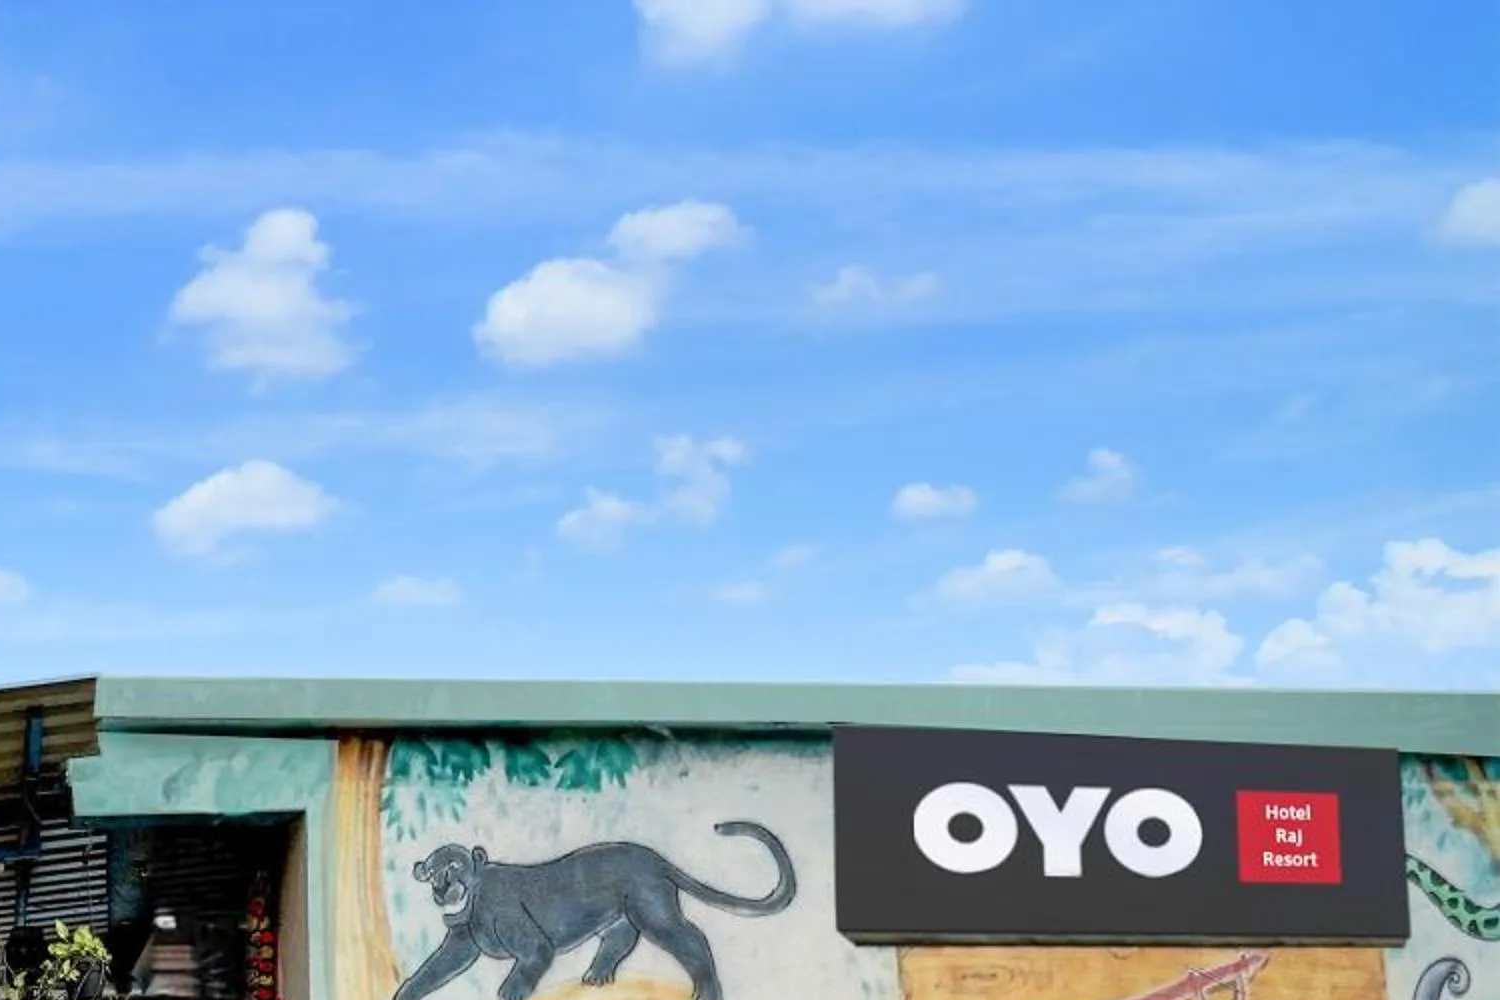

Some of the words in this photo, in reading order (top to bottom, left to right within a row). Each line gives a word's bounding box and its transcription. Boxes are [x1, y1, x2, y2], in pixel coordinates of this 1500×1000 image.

[1265, 804, 1311, 820] Hotel
[913, 782, 1203, 877] OYO
[1276, 828, 1303, 847] Raj
[1263, 851, 1319, 868] Resort
